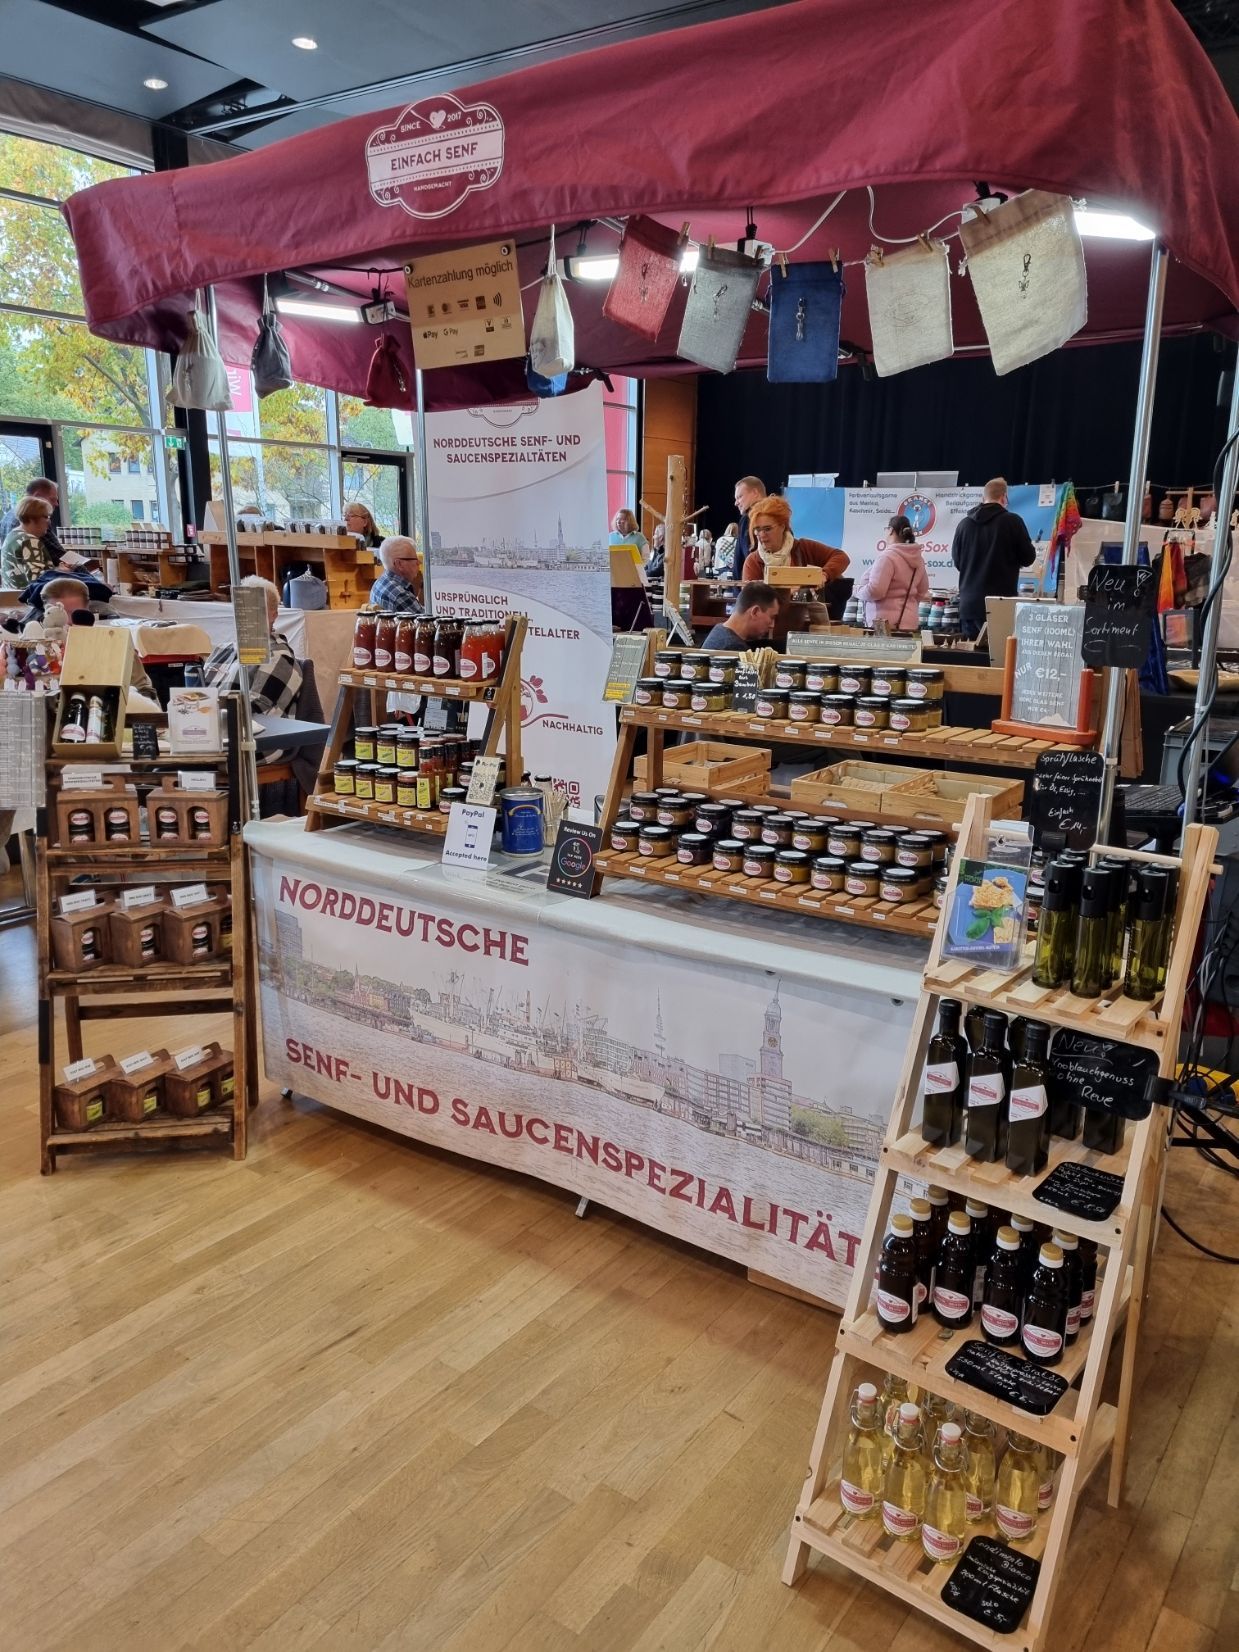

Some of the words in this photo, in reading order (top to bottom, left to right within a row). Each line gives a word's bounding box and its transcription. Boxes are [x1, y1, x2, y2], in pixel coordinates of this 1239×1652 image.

[447, 111, 462, 122] 2017
[400, 120, 422, 132] SINCE
[390, 149, 441, 171] EINFACH
[445, 142, 479, 160] SENF
[413, 181, 452, 192] HANDGEMACHT
[408, 267, 474, 289] Kartenzahlung
[475, 260, 513, 279] möglich
[433, 436, 517, 449] NORDDEUTSCHE
[520, 436, 553, 447] SENF-
[556, 434, 581, 446] UND
[446, 448, 567, 463] SAUCENSPEZIALTÄTEN
[434, 591, 508, 606] URSPRÜNGLICH
[1107, 598, 1126, 611] im
[436, 605, 456, 615] UND
[1028, 614, 1035, 622] 3
[1035, 612, 1069, 623] GLÄSER
[1021, 625, 1042, 635] SENF
[1085, 616, 1140, 636] Sortiment
[1021, 638, 1045, 648] IHRER
[1047, 639, 1074, 650] WAHL
[1014, 662, 1033, 680] NUR
[1034, 667, 1067, 682] €12,-
[542, 719, 604, 735] NACHHALTIG
[461, 808, 485, 818] PayPal
[563, 826, 581, 835] Review
[588, 831, 596, 839] On
[445, 849, 473, 860] Accepted
[473, 853, 488, 862] here
[560, 857, 586, 871] Google
[279, 875, 530, 967] NORDDEUTSCHE
[285, 1037, 363, 1084] SENF-
[371, 1070, 441, 1115] UND
[1056, 1071, 1085, 1085] ohne
